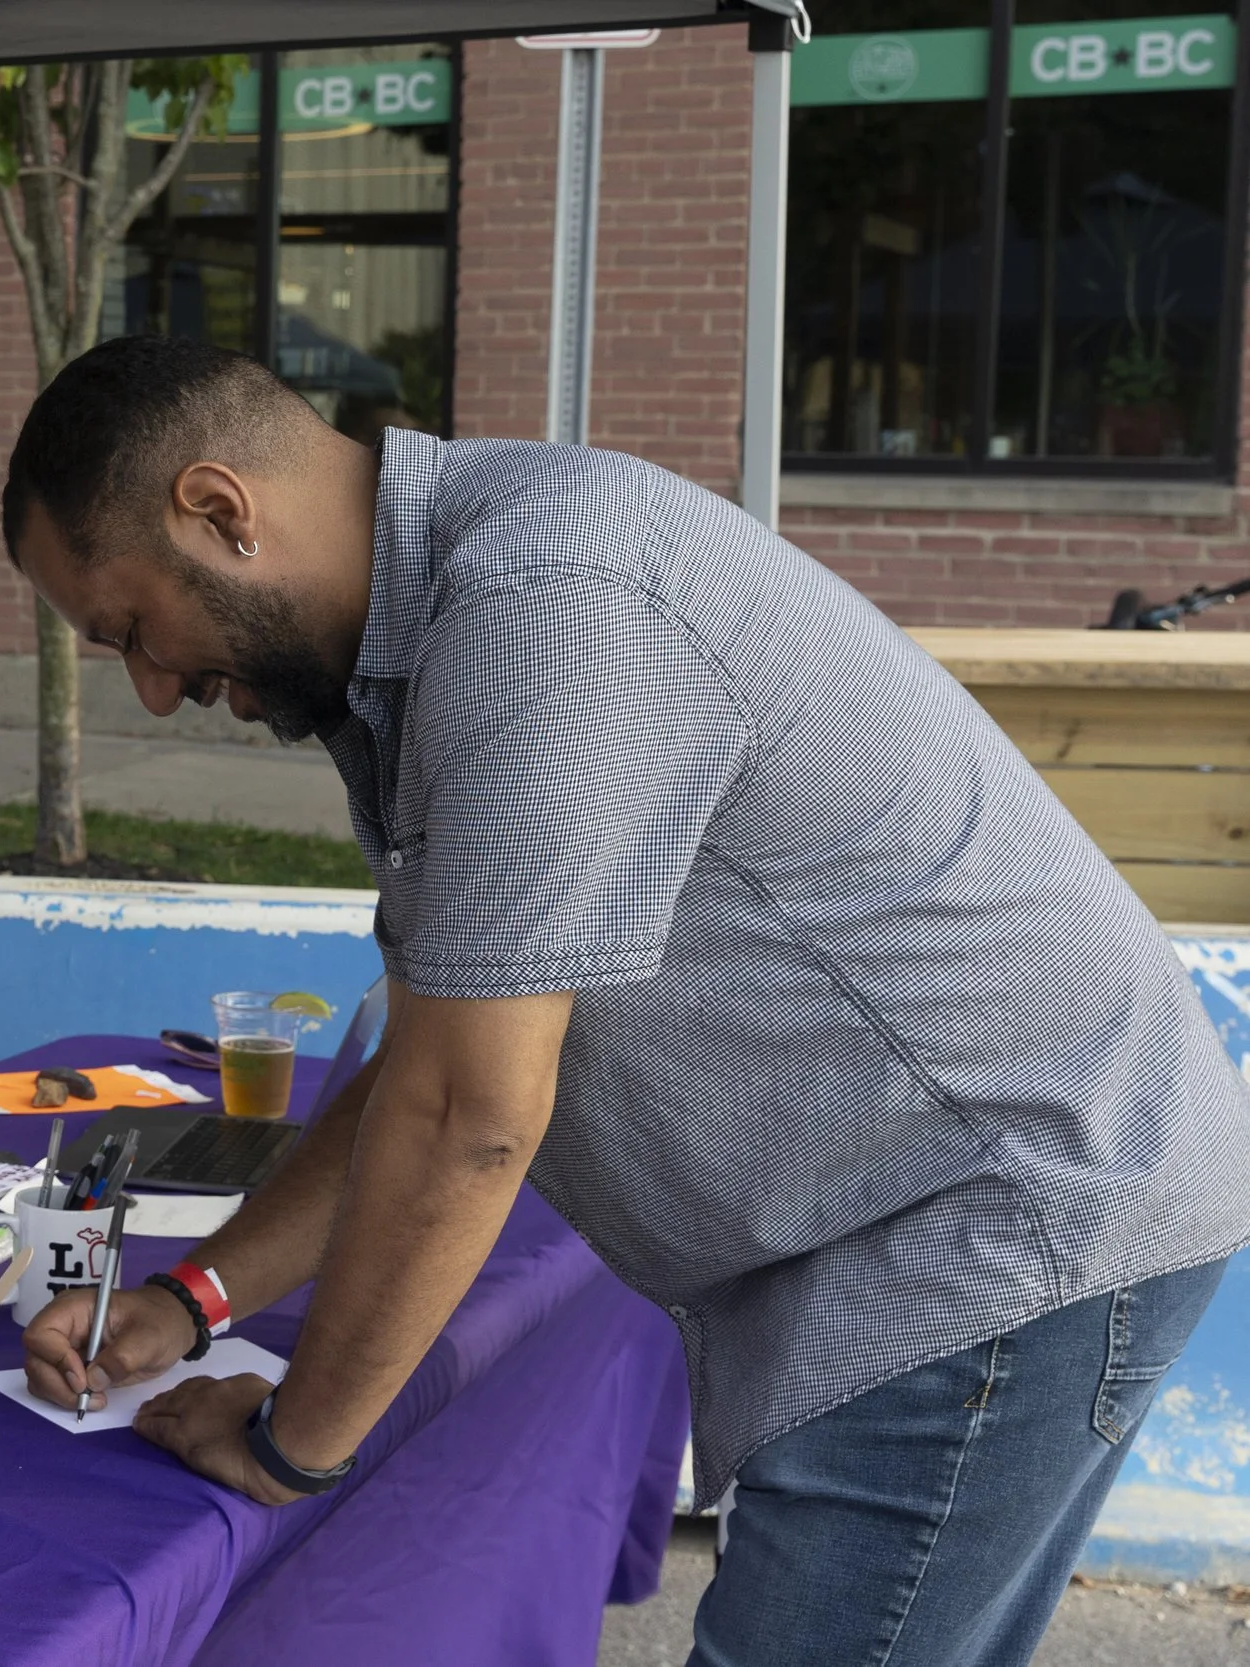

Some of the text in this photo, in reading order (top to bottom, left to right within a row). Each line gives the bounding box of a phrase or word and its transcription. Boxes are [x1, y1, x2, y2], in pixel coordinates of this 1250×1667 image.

[1030, 28, 1215, 82] CB BC
[294, 72, 436, 117] CB BC
